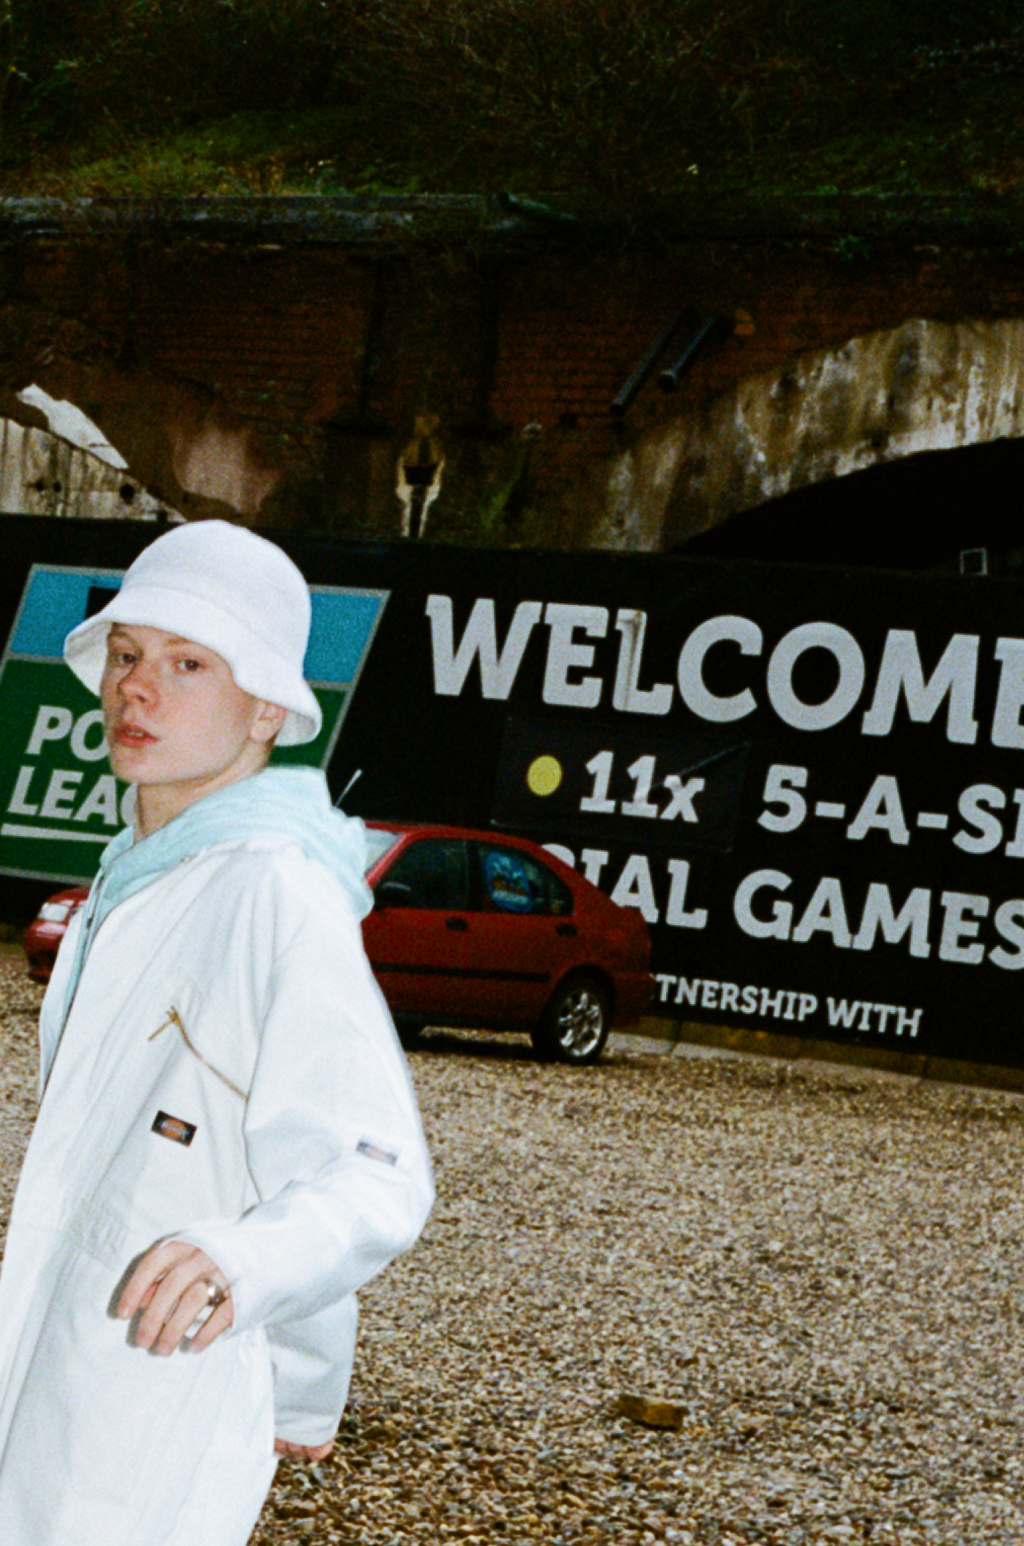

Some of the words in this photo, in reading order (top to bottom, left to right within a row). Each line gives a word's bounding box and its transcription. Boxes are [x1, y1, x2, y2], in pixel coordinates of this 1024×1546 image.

[425, 594, 1024, 750] WELCOME
[579, 750, 706, 823] 11x
[733, 868, 1024, 970] GAMES
[826, 997, 923, 1037] WITH
